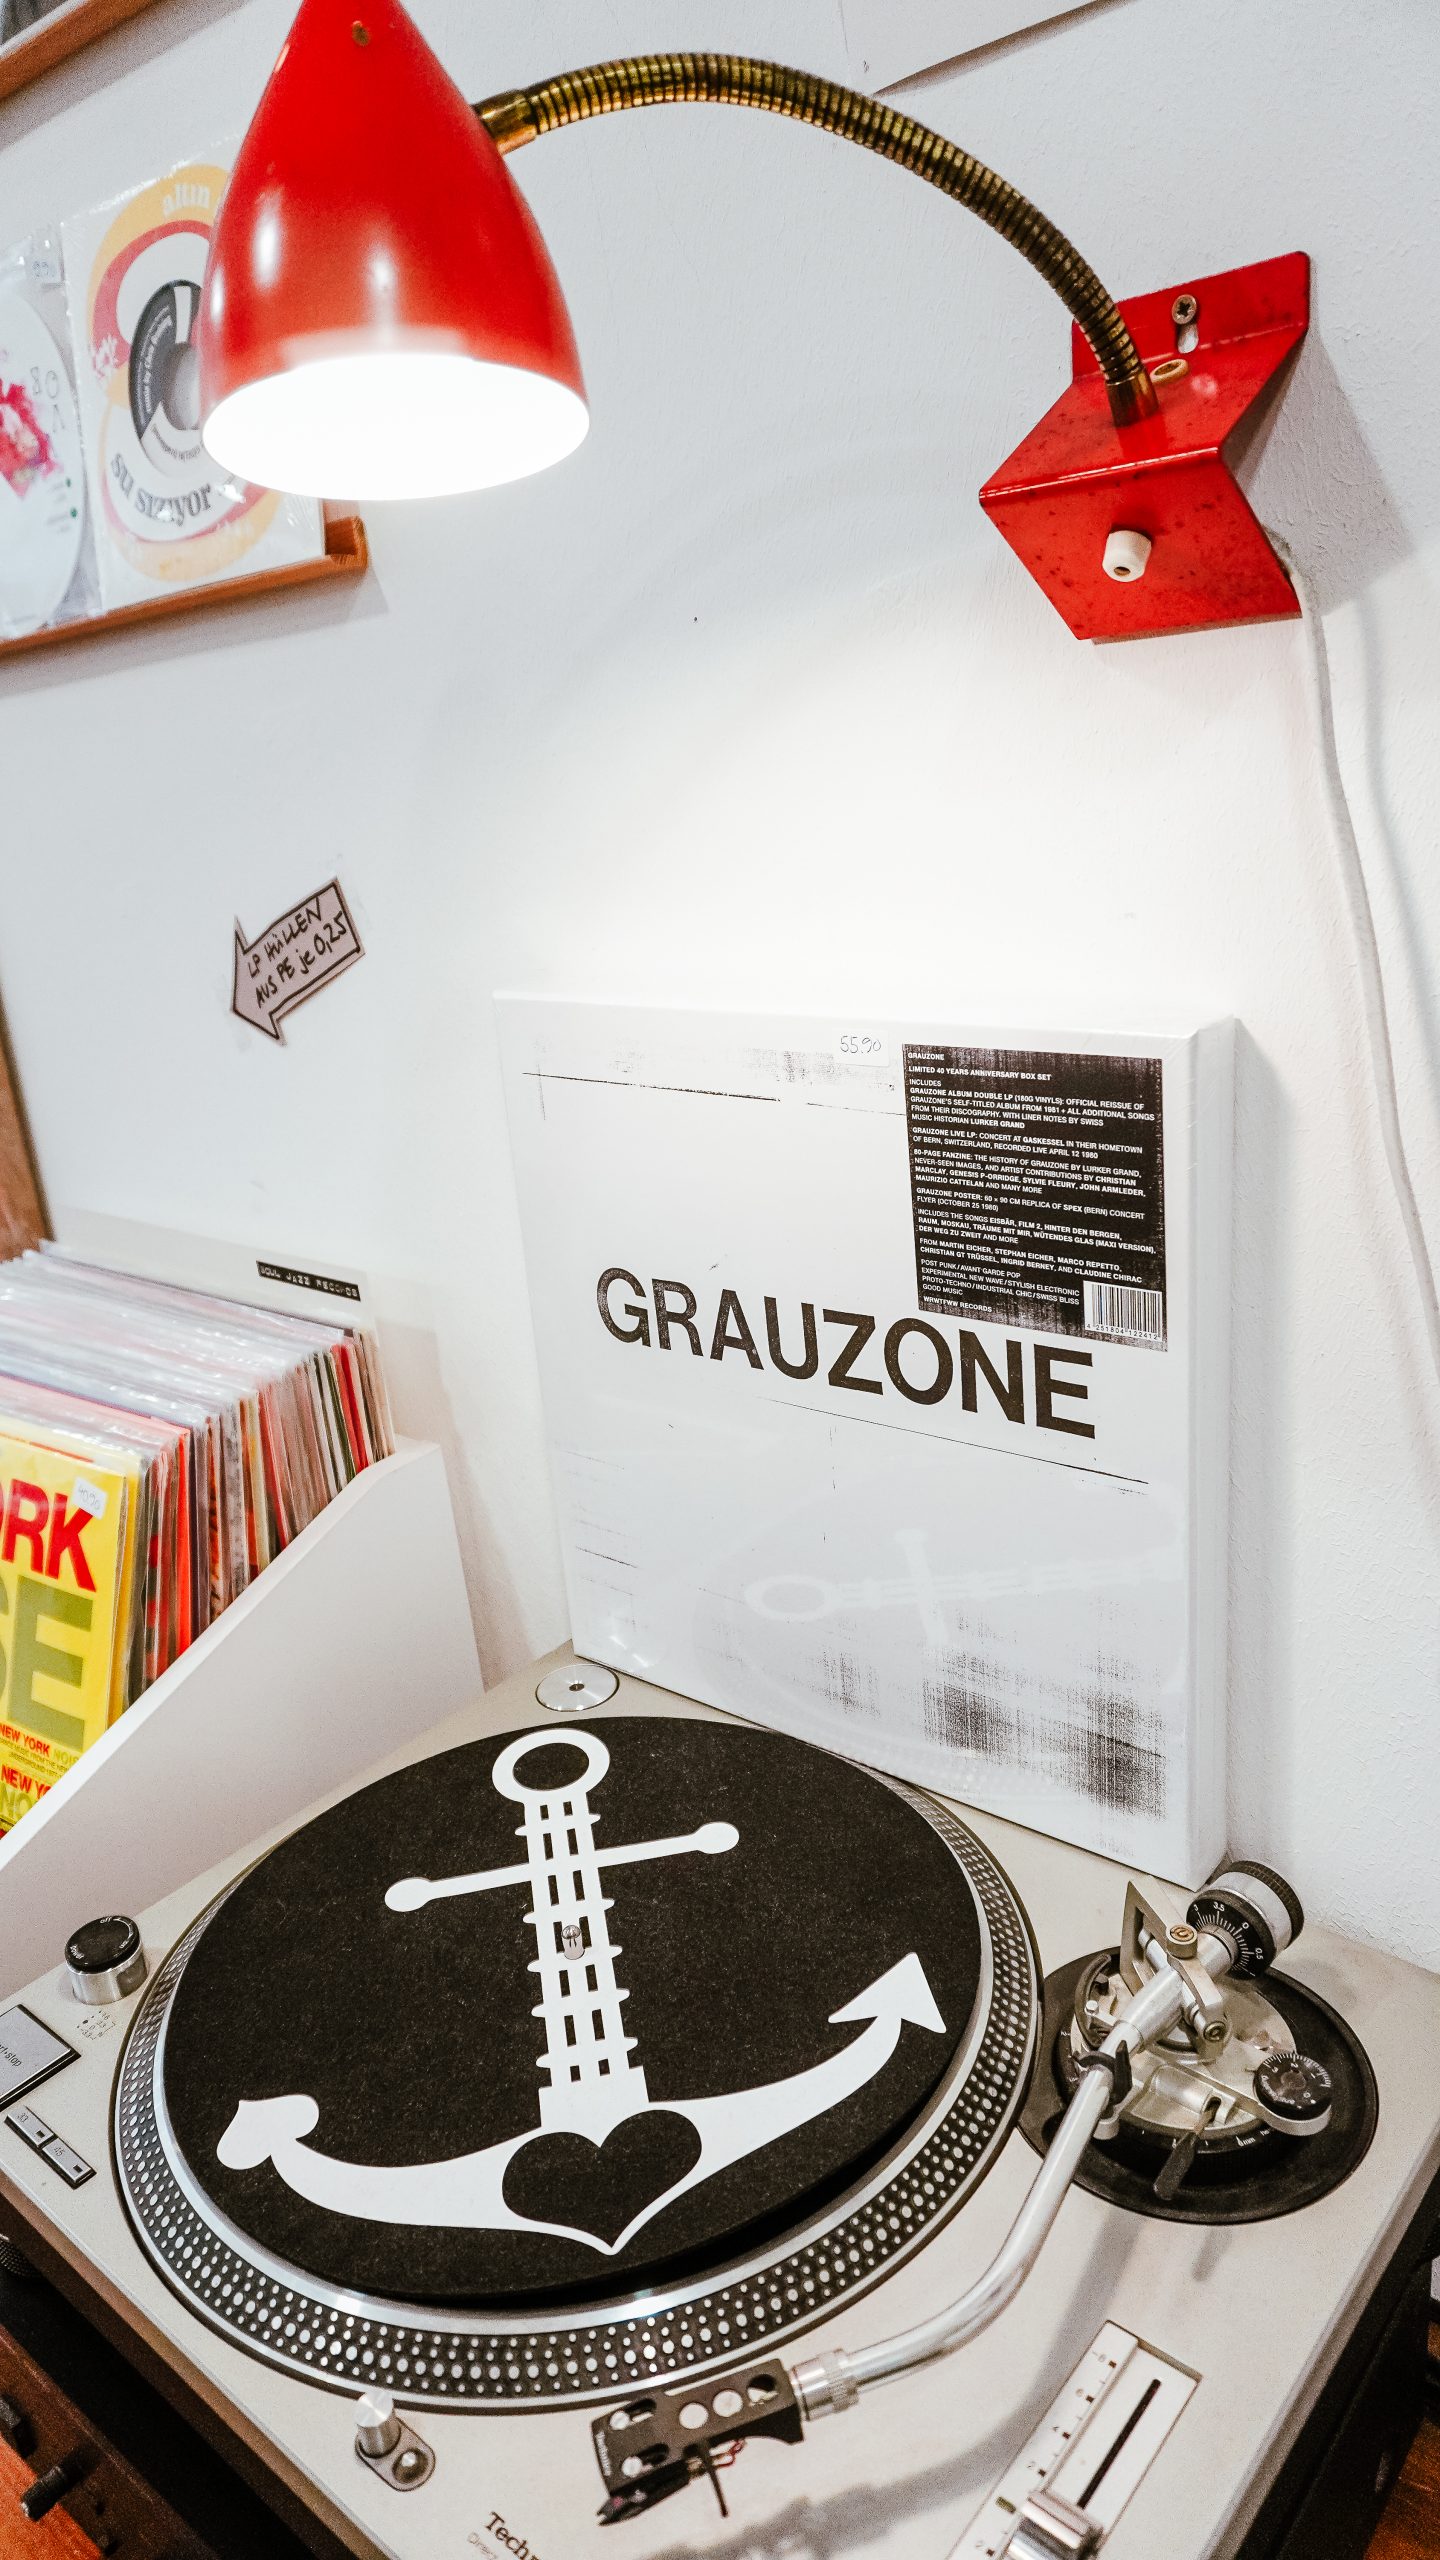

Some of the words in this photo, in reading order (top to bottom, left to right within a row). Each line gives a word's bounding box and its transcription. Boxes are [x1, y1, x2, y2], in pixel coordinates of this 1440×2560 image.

[908, 1052, 944, 1060] GRAUZONE
[910, 1079, 941, 1087] INCLUDES
[970, 1070, 1019, 1078] ANNIVERSARY
[910, 1087, 946, 1095] GRAUZONE
[974, 1092, 1002, 1100] DOUBLE
[1066, 1099, 1098, 1107] OFFICIAL
[1100, 1101, 1132, 1109] REISSUE
[954, 1099, 995, 1108] SELF-TITLED
[996, 1102, 1020, 1110] ALBUM
[1082, 1109, 1126, 1118] ADDITIONAL
[934, 1115, 969, 1123] HISTORIAN
[971, 1118, 998, 1126] LURKER
[912, 1127, 949, 1136] GRAUZONE
[979, 1133, 1011, 1141] CONCERT
[1023, 1137, 1065, 1146] GASKESSEL
[1099, 1144, 1142, 1154] HOMETOWN
[994, 1143, 1031, 1152] RECORDED
[914, 1149, 941, 1157] 80-PAGE
[989, 1156, 1018, 1165] HISTORY
[1031, 1161, 1069, 1170] GRAUZONE
[1083, 1166, 1111, 1174] LURKER
[915, 1157, 954, 1167] NEVER-SEEN
[1001, 1166, 1024, 1174] ARTIST
[1026, 1169, 1082, 1180] CONTRIBUTIONS
[1096, 1176, 1136, 1186] CHRISTIAN
[950, 1170, 979, 1178] GENESIS
[1023, 1177, 1046, 1185] SYLVIE
[916, 1175, 948, 1183] MAURIZIO
[949, 1178, 984, 1187] CATTELAN
[1023, 1186, 1042, 1194] MORE
[916, 1187, 952, 1197] GRAUZONE
[1022, 1200, 1050, 1208] REPLICA
[1063, 1204, 1082, 1212] SPEX
[1084, 1207, 1108, 1215] (BERN)
[1109, 1210, 1144, 1219] CONCERT
[938, 1199, 970, 1208] (OCTOBER
[918, 1209, 949, 1218] INCLUDES
[965, 1215, 988, 1223] SONGS
[1018, 1221, 1035, 1229] FILM
[1044, 1225, 1070, 1233] HINTER
[999, 1236, 1018, 1244] MORE
[1074, 1237, 1094, 1245] GLAS
[1096, 1240, 1116, 1248] (MAXI
[920, 1238, 938, 1246] FROM
[940, 1241, 964, 1249] MARTIN
[995, 1249, 1026, 1258] STEPHAN
[1058, 1257, 1084, 1266] MARCO
[920, 1246, 954, 1256] CHRISTIAN
[1074, 1268, 1111, 1278] CLAUDINE
[1113, 1273, 1142, 1283] CHIRAC
[943, 1287, 963, 1295] MUSIC
[1037, 1285, 1079, 1296] ELECTRONIC
[960, 1302, 992, 1312] RECORDS
[597, 1267, 1096, 1439] GRAUZONE
[0, 1478, 97, 1593] RK
[23, 1733, 50, 1758] YORK
[2, 1764, 32, 1794] NEW
